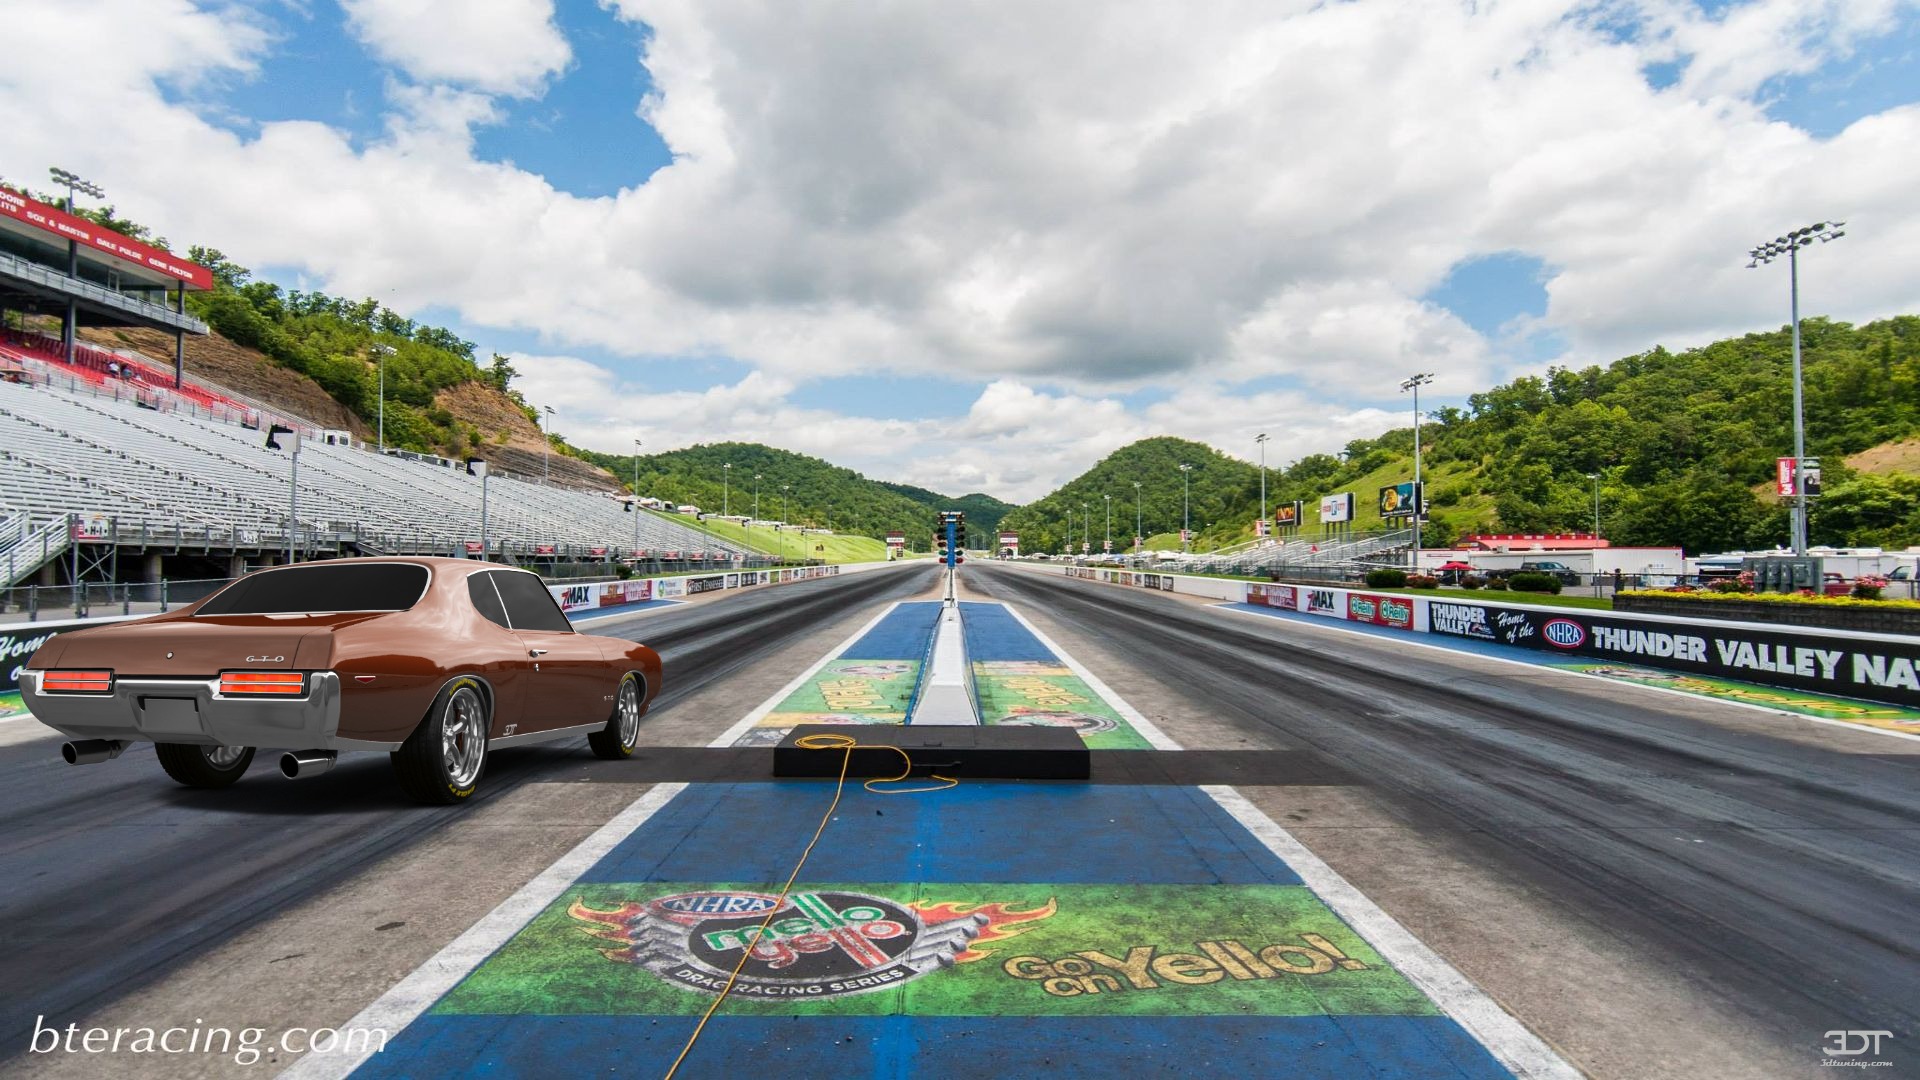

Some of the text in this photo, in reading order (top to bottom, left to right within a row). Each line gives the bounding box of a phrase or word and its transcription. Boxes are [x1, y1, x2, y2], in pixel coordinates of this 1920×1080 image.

[26, 211, 45, 224] SOX
[57, 222, 90, 240] MARTIN
[96, 237, 116, 250] DALE
[1431, 603, 1487, 624] THUNDER
[1497, 611, 1526, 627] Home
[1433, 618, 1472, 635] VALLEY
[1506, 626, 1517, 643] of
[1519, 622, 1534, 638] the
[1547, 624, 1581, 643] NHRA
[246, 655, 285, 663] GTO
[1592, 625, 1708, 663] THUNDER
[1716, 638, 1844, 680] VALLEY
[672, 896, 770, 914] NHRA
[702, 893, 885, 952] mello
[1003, 951, 1094, 980] Go
[1074, 931, 1370, 991] Yello!
[675, 968, 906, 996] DRAG RACING SERIES
[1041, 972, 1124, 998] on
